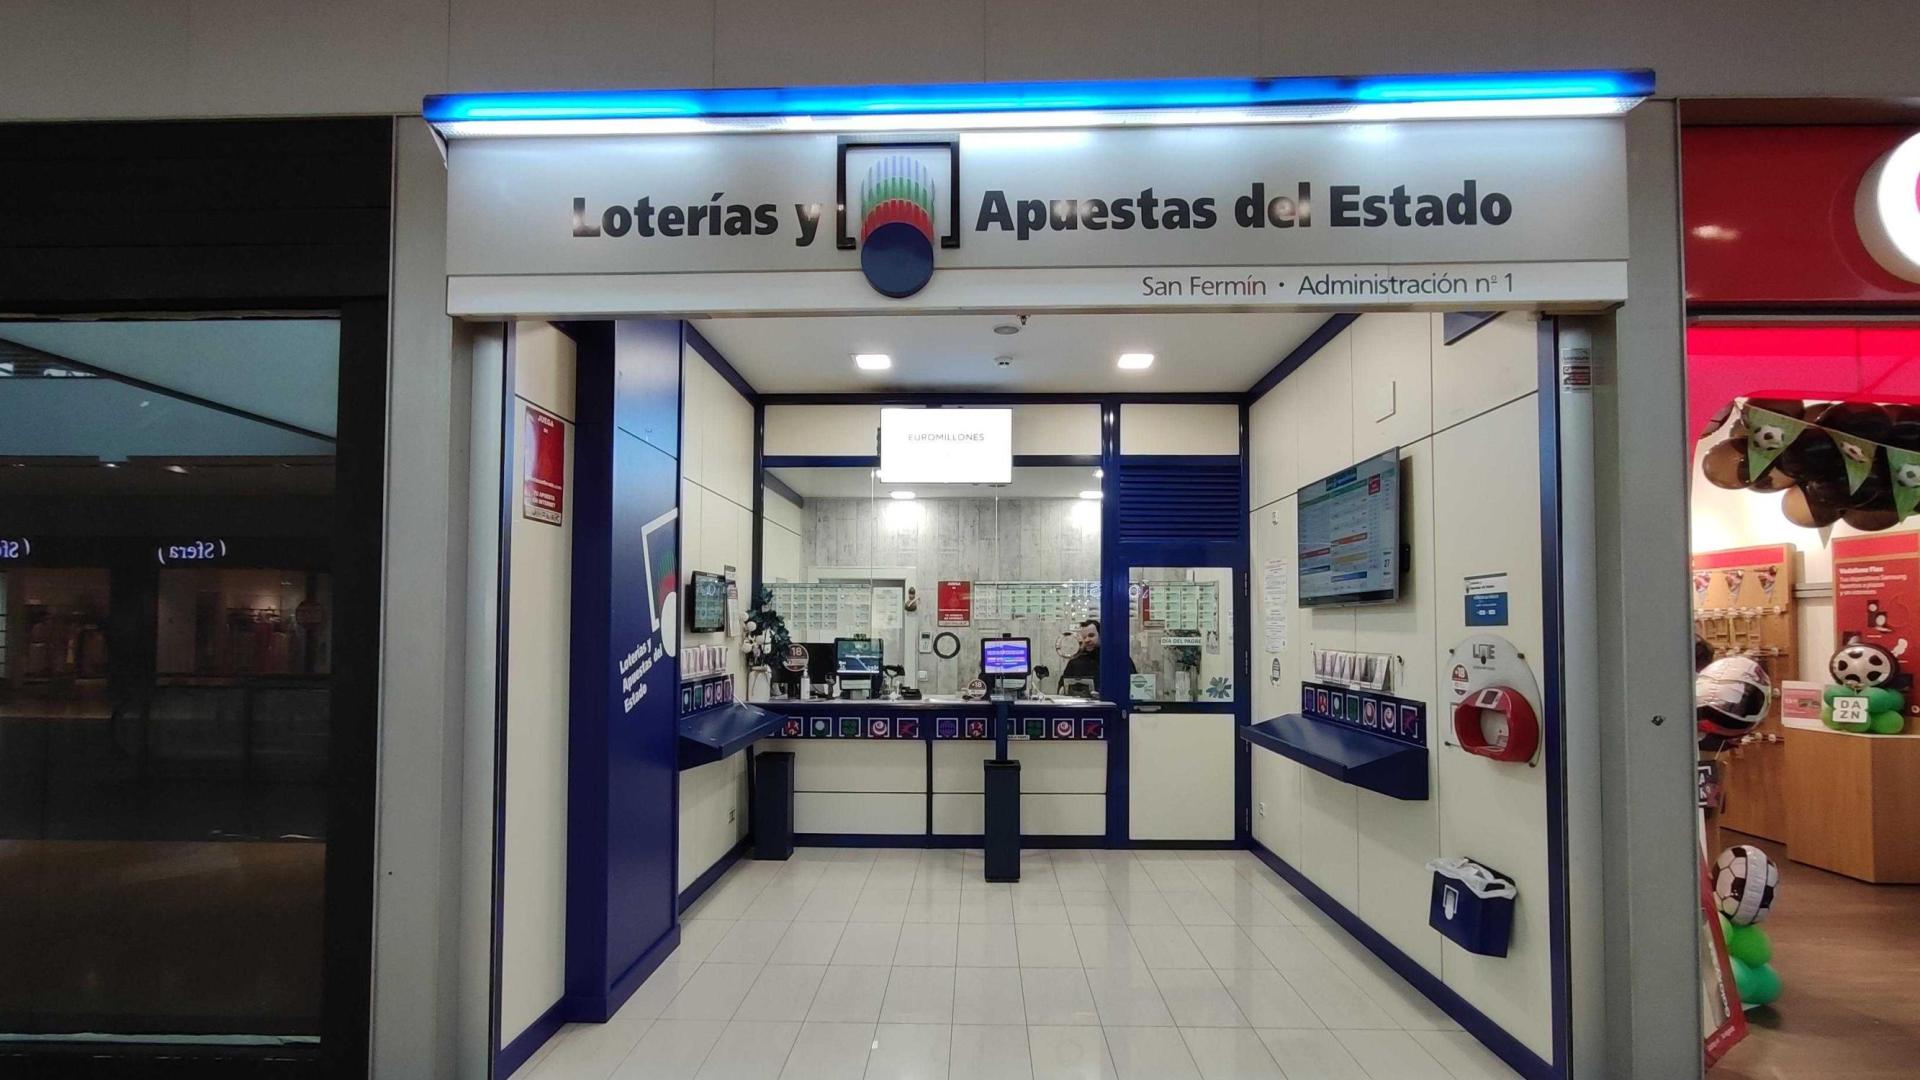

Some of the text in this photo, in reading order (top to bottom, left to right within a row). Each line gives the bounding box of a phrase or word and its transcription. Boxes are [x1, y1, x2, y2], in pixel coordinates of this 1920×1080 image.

[573, 179, 1513, 247] Loterías y Apuestas del Estado
[1143, 276, 1182, 297] San
[1190, 275, 1267, 296] Fermín
[1298, 272, 1468, 296] Administración
[1504, 273, 1512, 292] 1
[908, 433, 985, 441] EUROMILLONES
[622, 657, 652, 694] Apuestas
[624, 682, 648, 713] Estado
